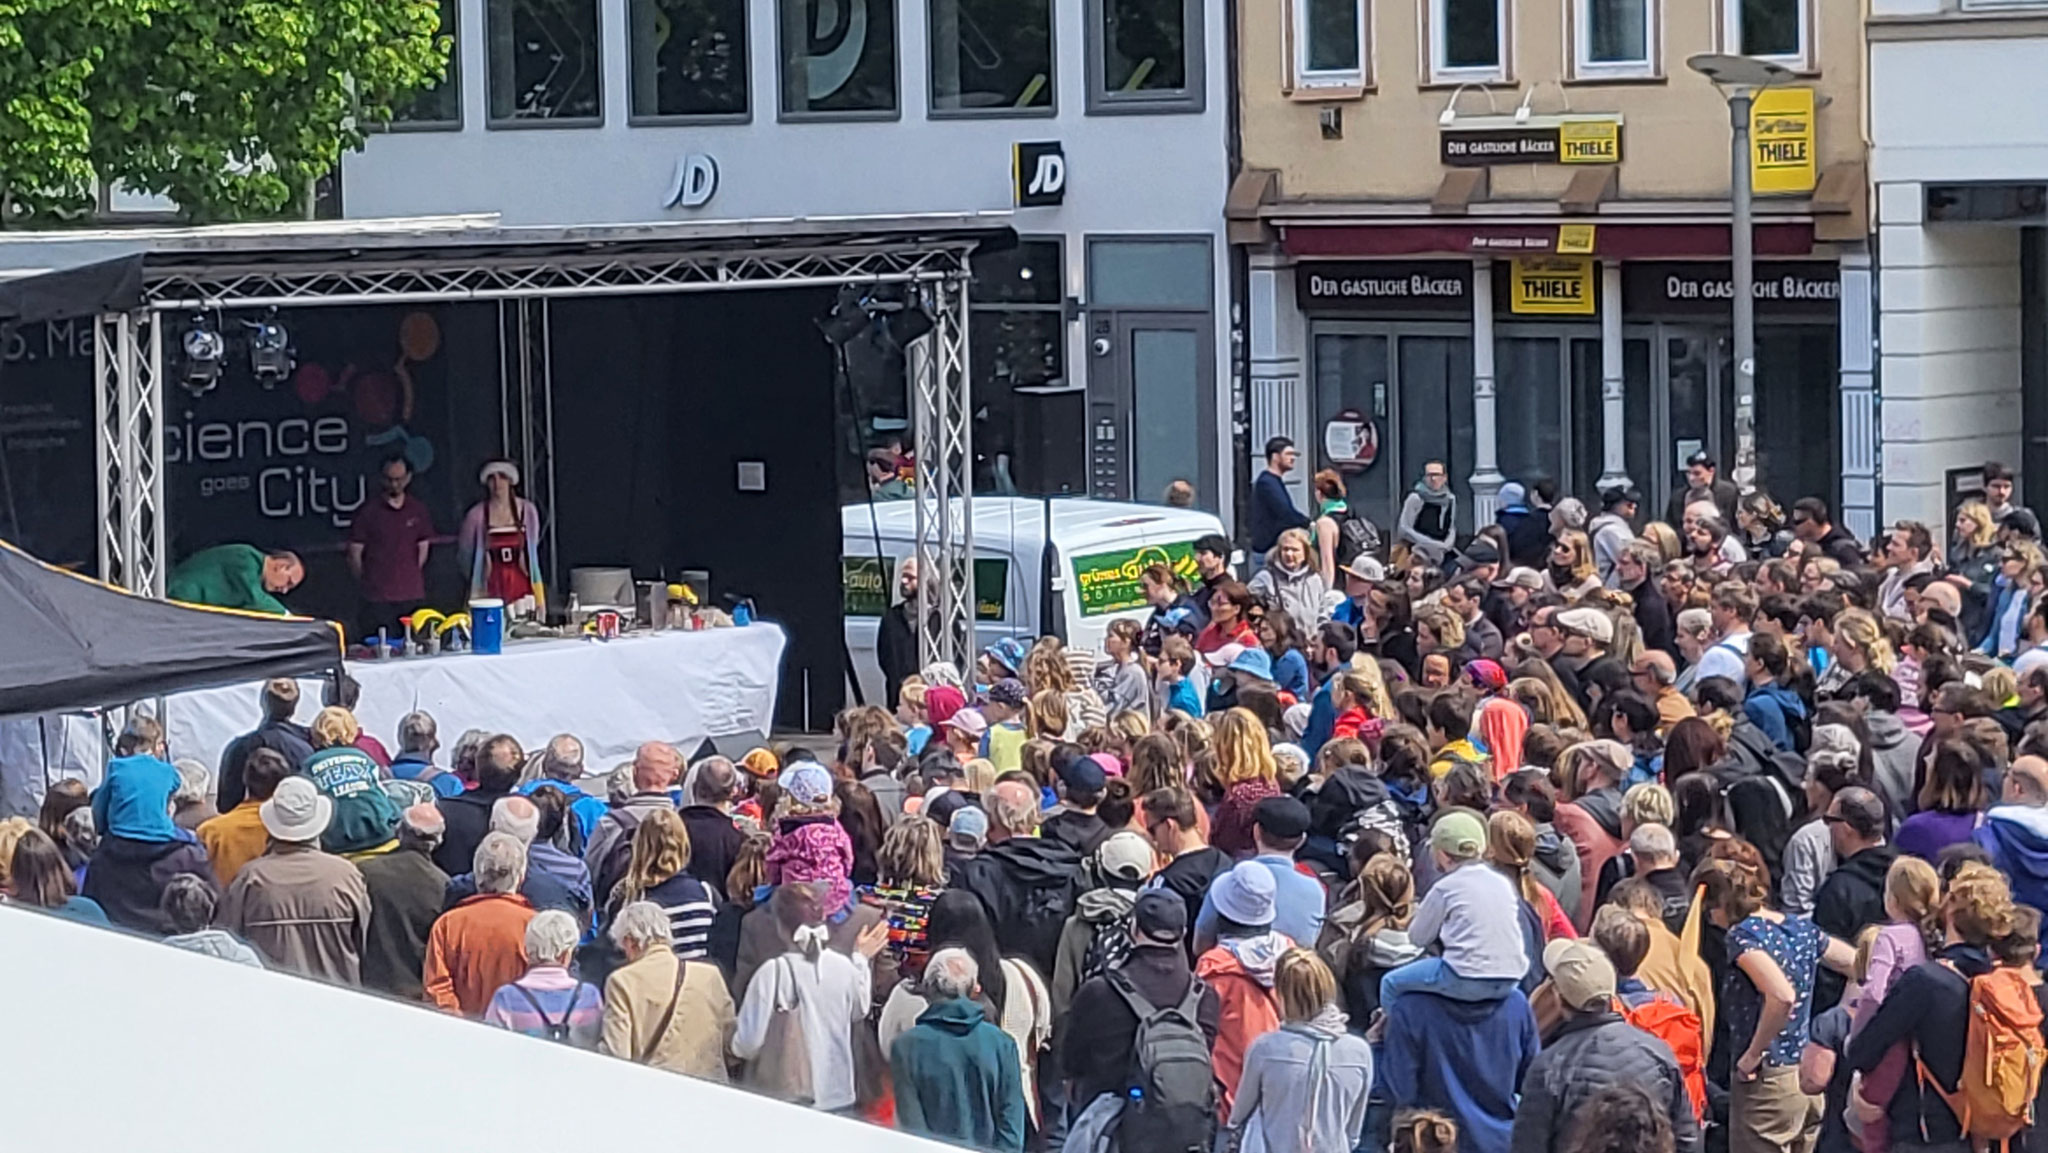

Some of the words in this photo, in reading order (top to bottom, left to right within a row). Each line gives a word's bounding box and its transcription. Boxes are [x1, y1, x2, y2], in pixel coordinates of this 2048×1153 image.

[1565, 141, 1614, 156] THIELE
[1757, 142, 1807, 162] THIELE
[664, 154, 719, 208] JD
[1029, 154, 1064, 195] JD
[1310, 275, 1338, 295] DER
[1341, 279, 1408, 296] GASTLICHE
[1411, 275, 1463, 295] BÄCKER
[1521, 280, 1582, 298] THIELE
[1667, 276, 1698, 298] DER
[1702, 280, 1779, 298] GASCHE
[164, 411, 348, 462] cience
[200, 475, 250, 496] goes
[258, 465, 365, 527] City
